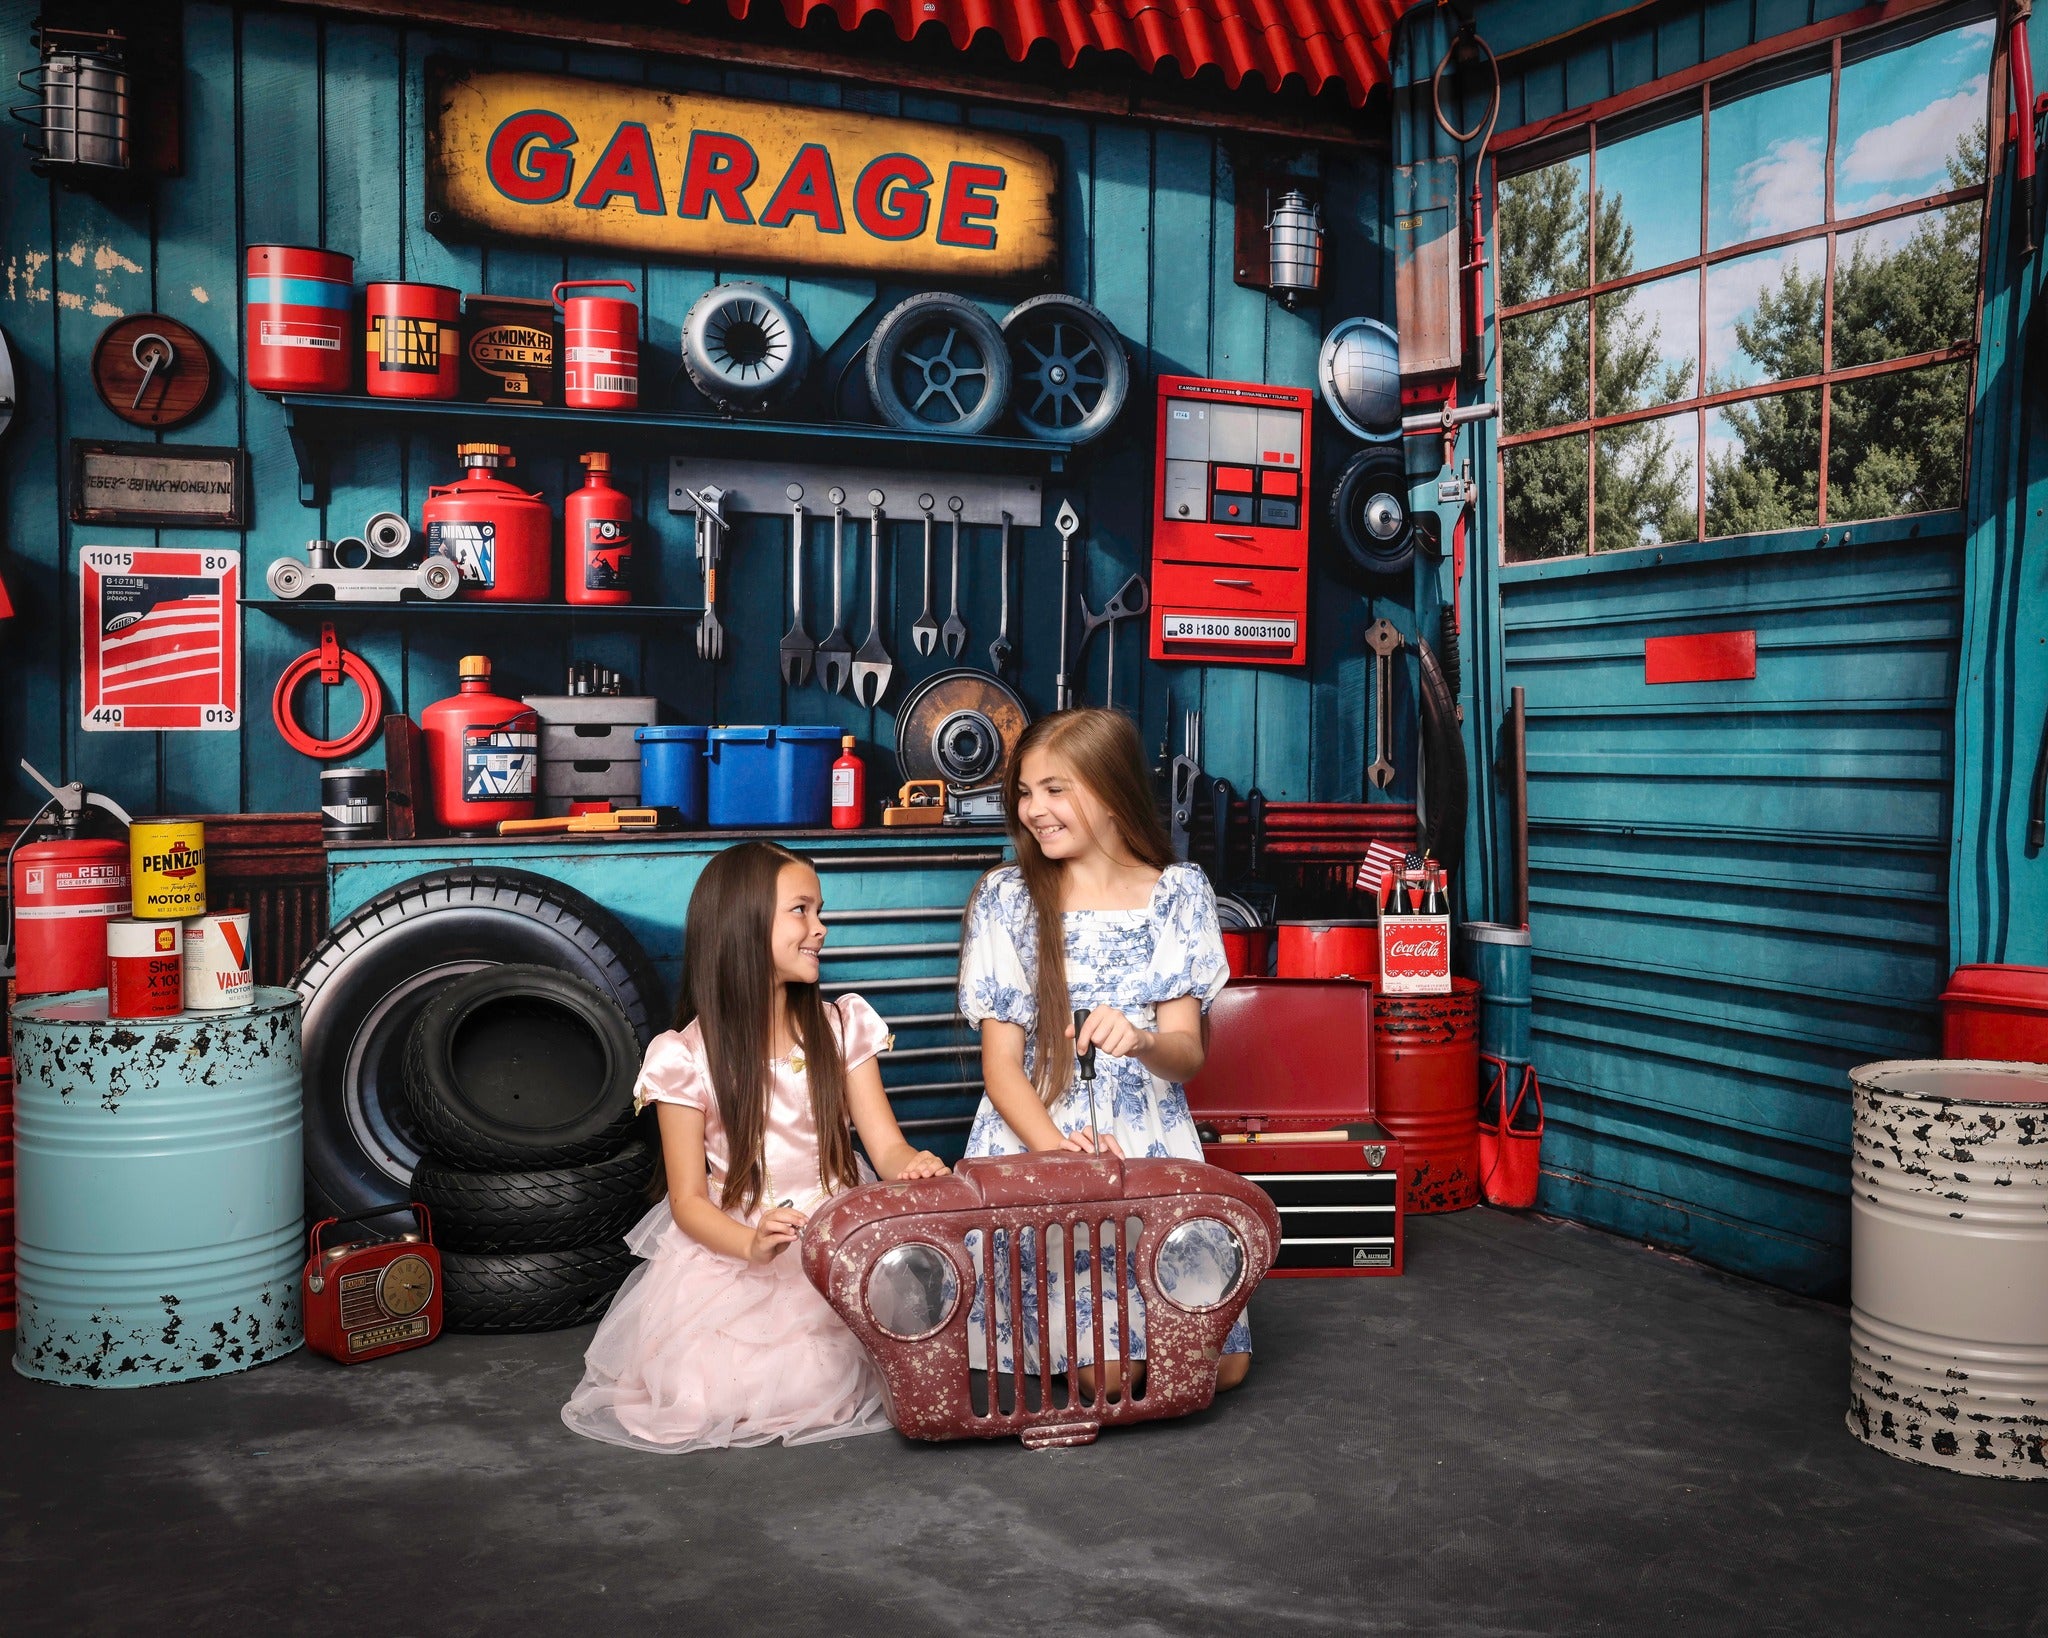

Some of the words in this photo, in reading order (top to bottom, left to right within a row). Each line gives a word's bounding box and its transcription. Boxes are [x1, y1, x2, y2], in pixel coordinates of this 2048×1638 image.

[486, 109, 1006, 250] GARAGE
[90, 553, 132, 566] 11015
[205, 556, 227, 569] 80
[1179, 623, 1194, 635] 88
[92, 709, 122, 723] 440
[206, 709, 233, 723] 013
[147, 894, 191, 905] MOTOR
[1391, 940, 1442, 957] Coca-Cola
[149, 959, 179, 974] Shell
[147, 975, 157, 989] X
[161, 973, 180, 987] 100
